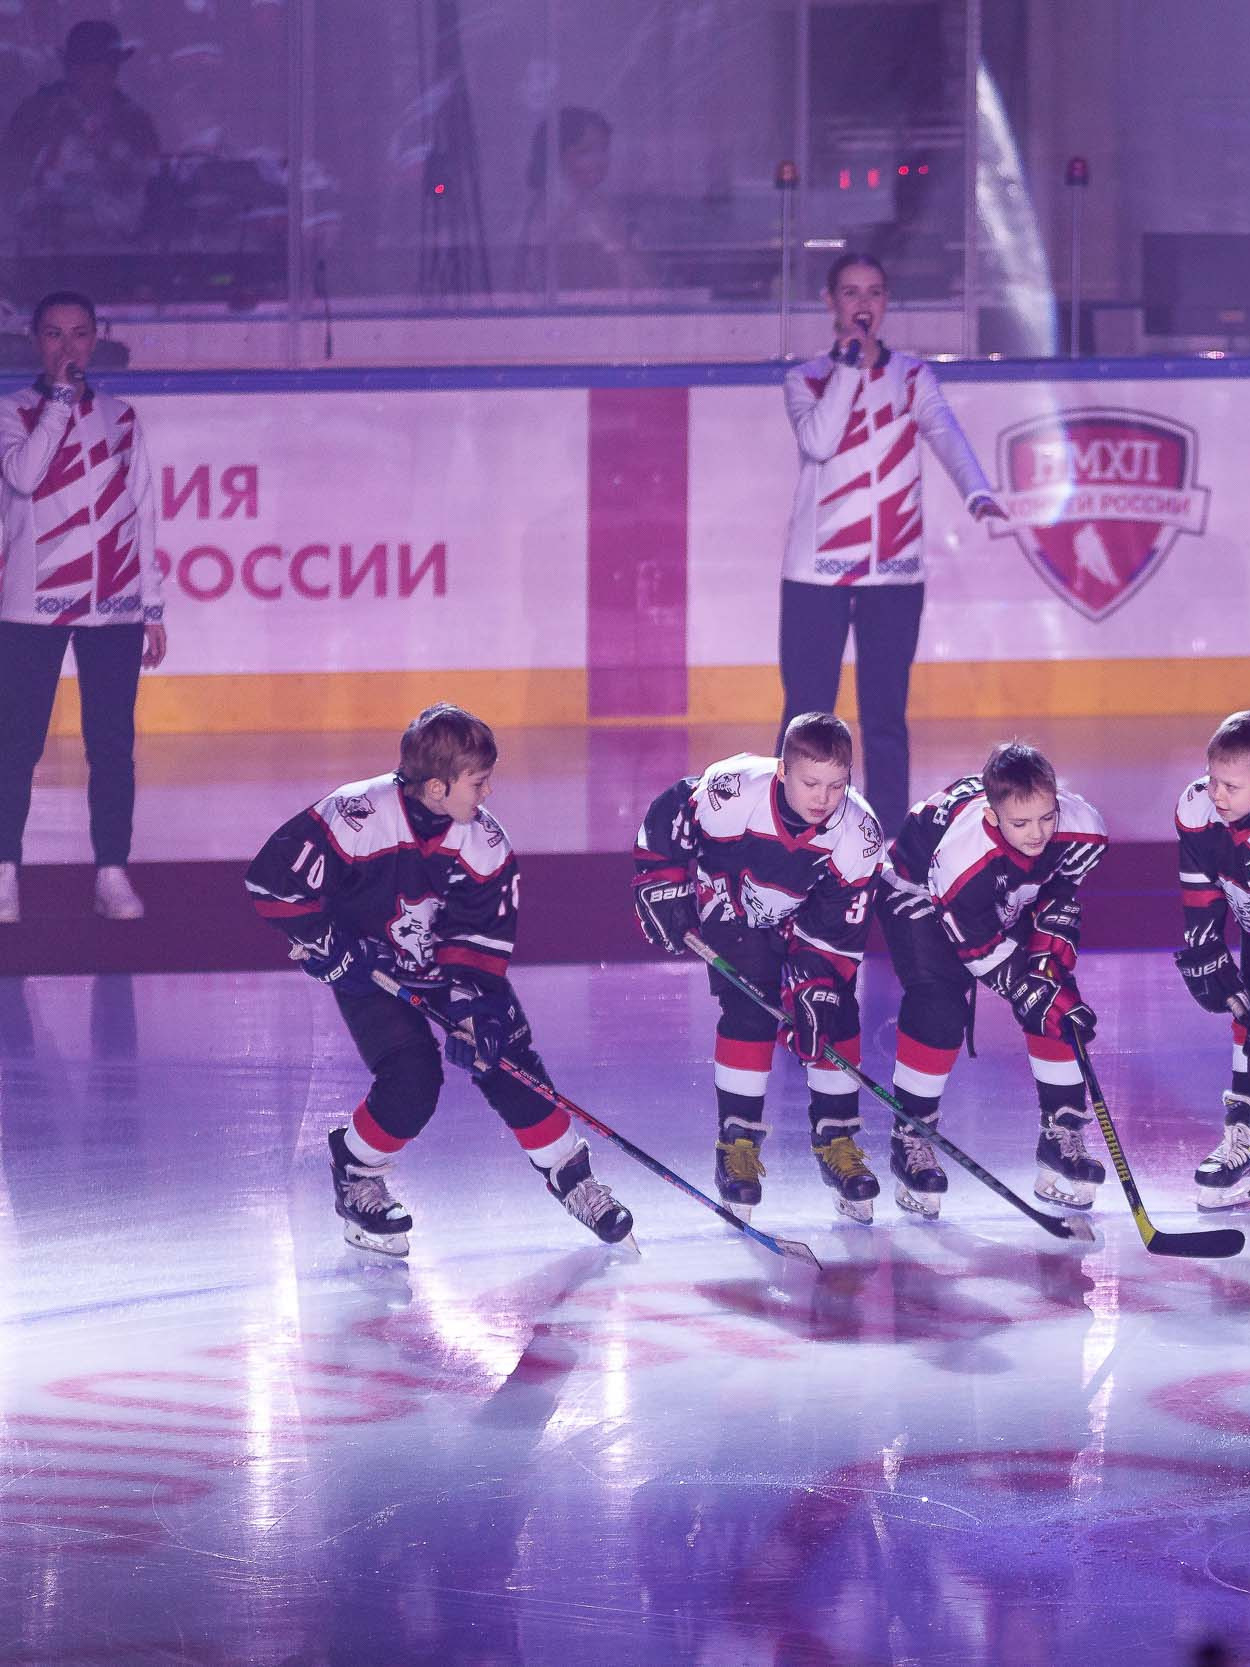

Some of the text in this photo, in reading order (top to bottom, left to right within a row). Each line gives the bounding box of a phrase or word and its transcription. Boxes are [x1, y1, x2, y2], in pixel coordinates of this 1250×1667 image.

[161, 464, 258, 520] ИЯ
[290, 841, 326, 889] 10
[1182, 952, 1230, 978] AUER
